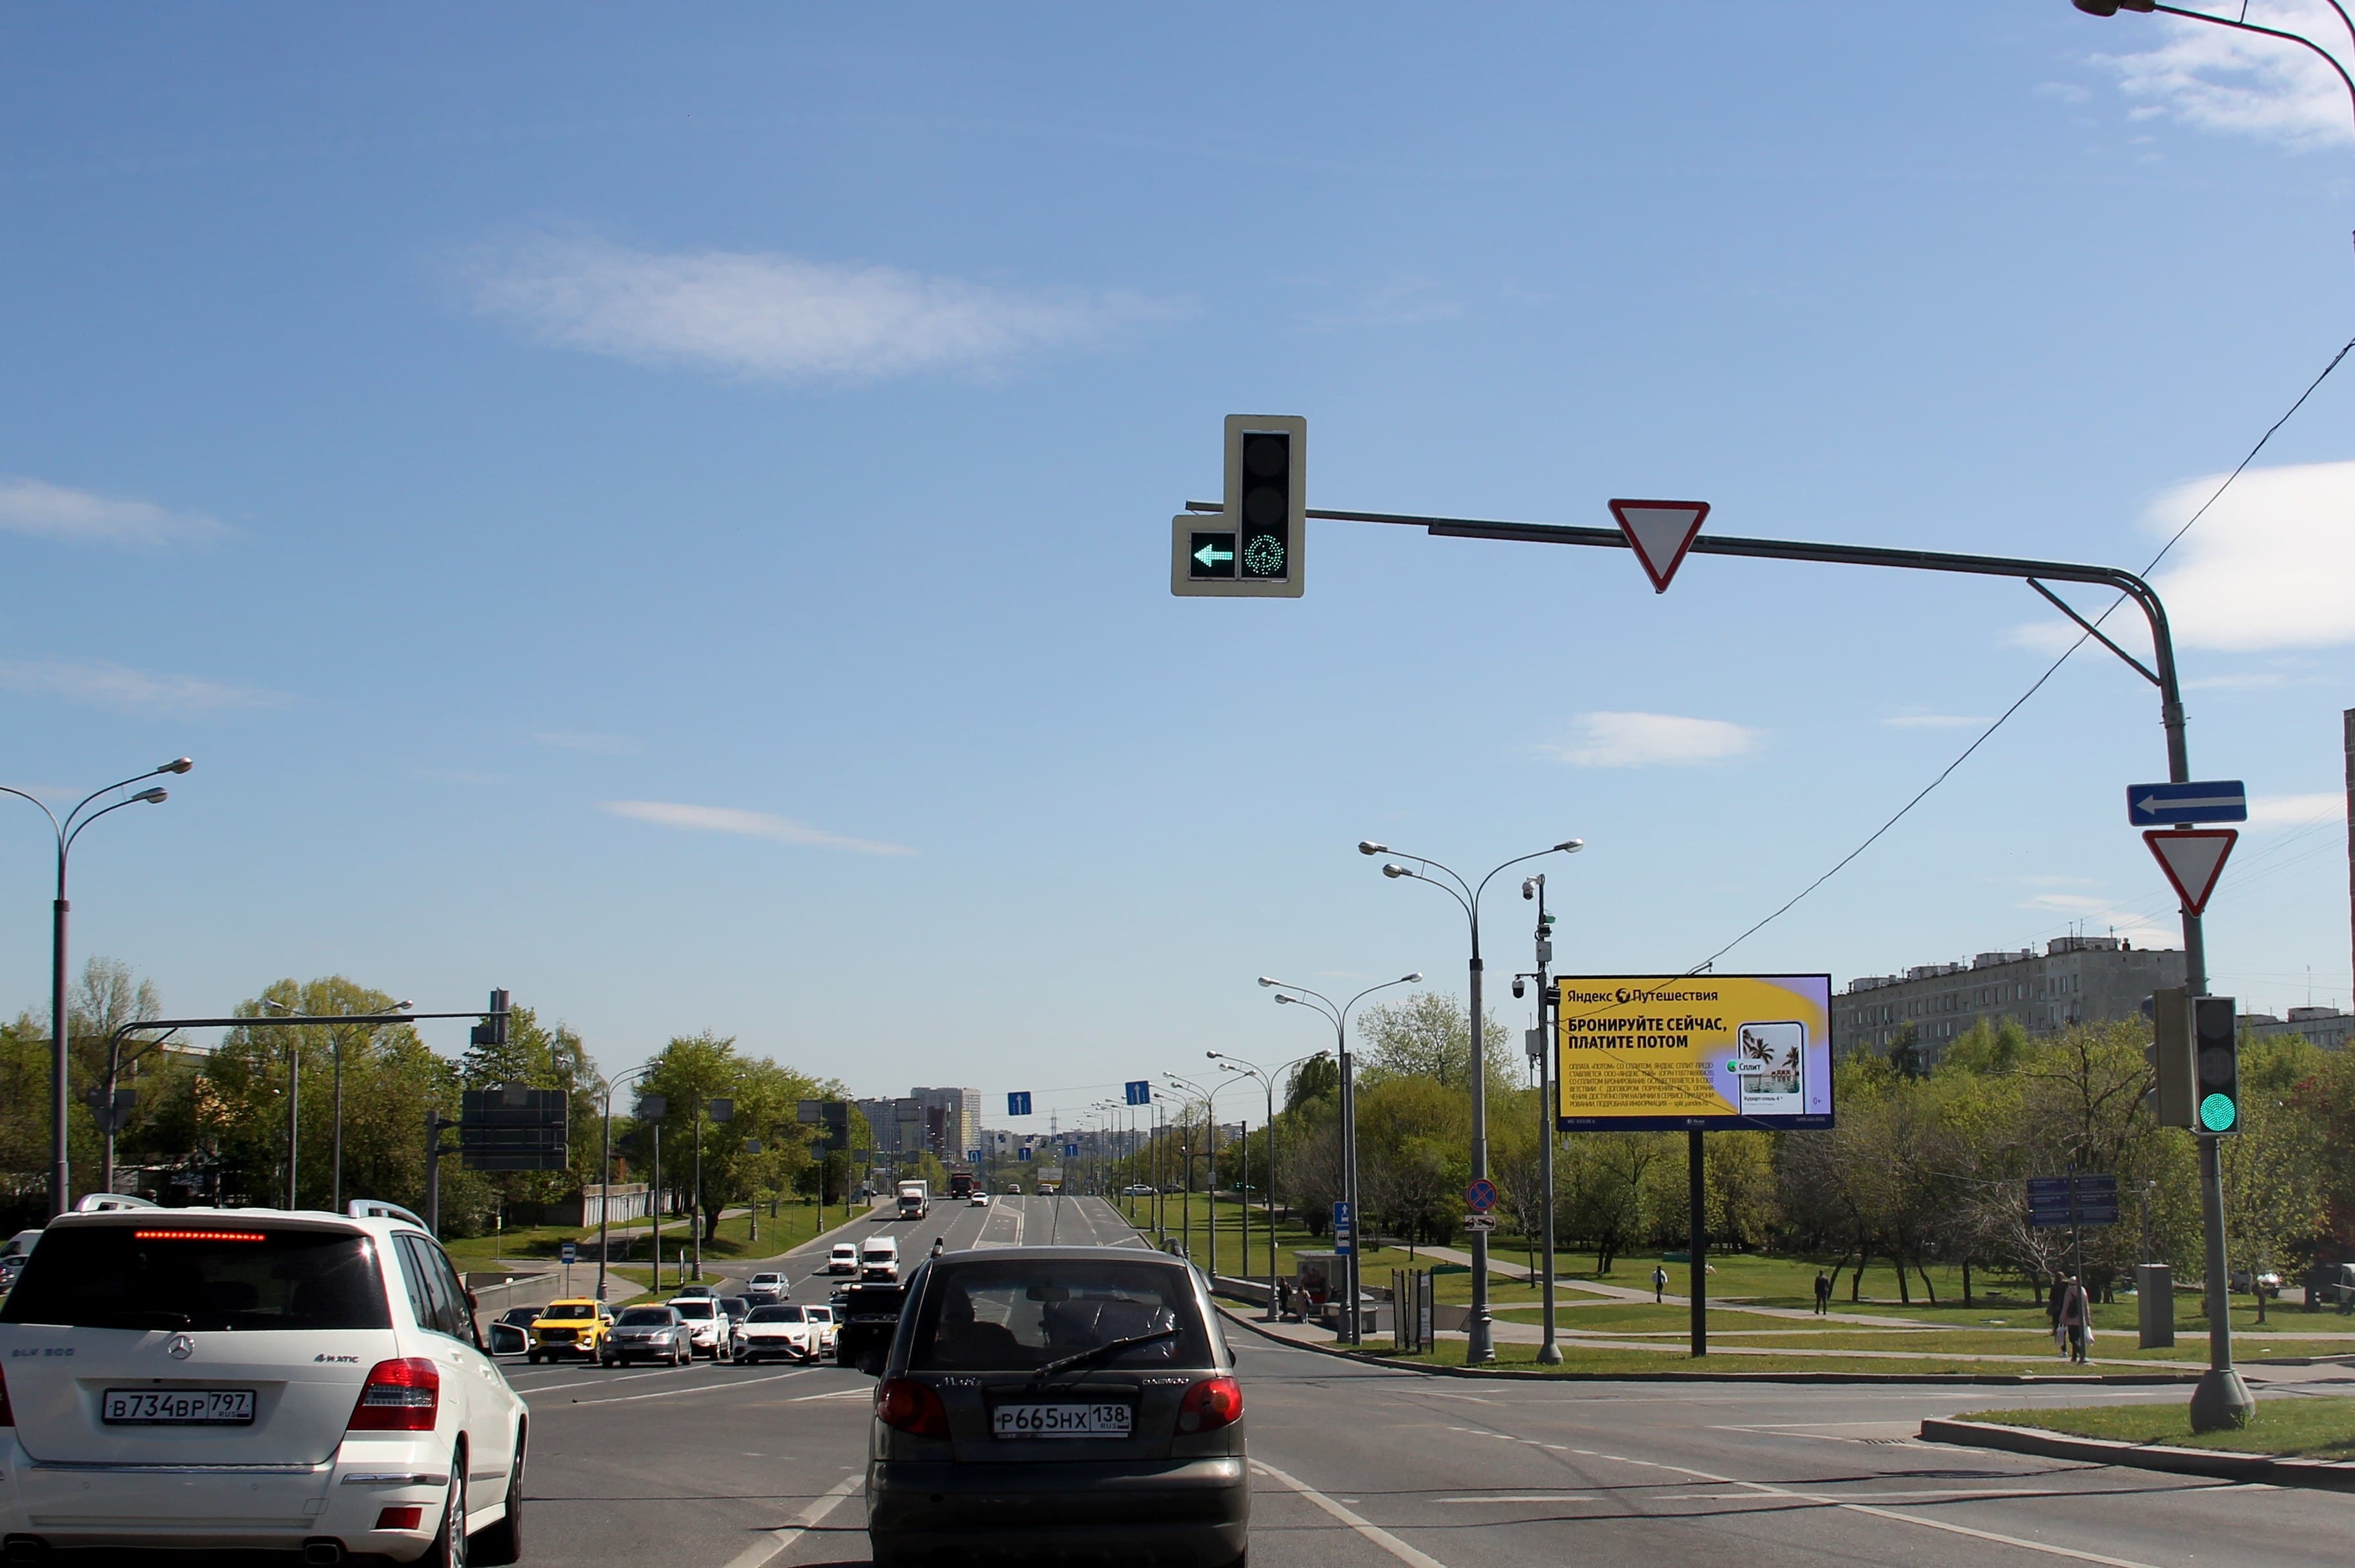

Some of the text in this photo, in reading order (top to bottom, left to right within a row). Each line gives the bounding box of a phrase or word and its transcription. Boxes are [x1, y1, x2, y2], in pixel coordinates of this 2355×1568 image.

[1568, 989, 1718, 1003] Яндекс Путешествия
[1569, 1014, 1727, 1032] БРОНИРУЙТЕ СЕЙЧАС,
[1569, 1035, 1688, 1049] ПЛАТИТЕ ПОТОМ
[1739, 1063, 1761, 1071] Сплит
[113, 1394, 246, 1417] В734ВР 797
[1001, 1407, 1125, 1429] Р665НХ 138
